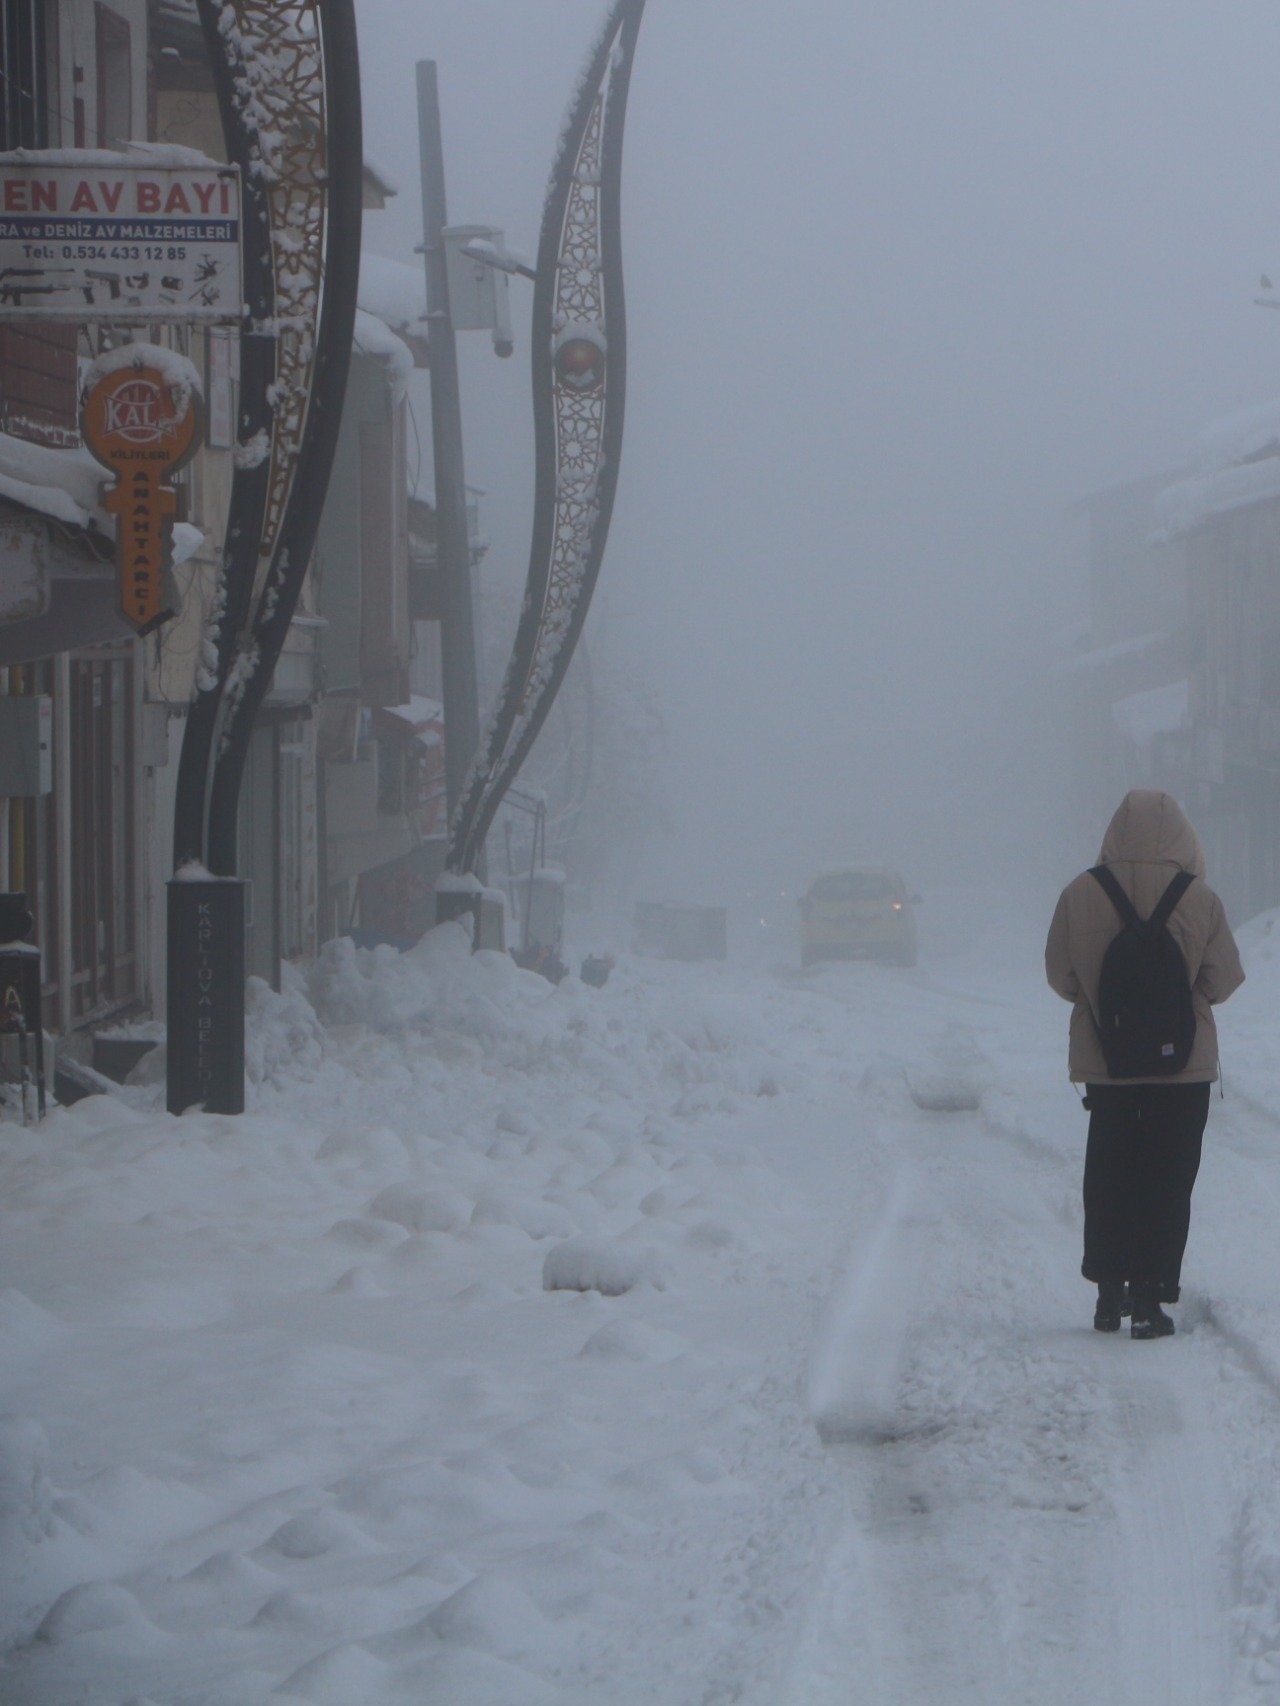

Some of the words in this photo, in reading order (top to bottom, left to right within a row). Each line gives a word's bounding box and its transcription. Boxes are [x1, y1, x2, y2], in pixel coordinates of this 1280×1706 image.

[4, 180, 57, 213] EN
[70, 181, 124, 213] AV
[22, 226, 40, 237] ve
[45, 221, 91, 237] DENİZ
[96, 225, 118, 238] AV
[121, 223, 231, 240] MALZEMELERİ
[23, 245, 54, 259] Tel:
[62, 245, 106, 259] 0.534
[110, 246, 139, 260] 433
[147, 247, 163, 260] 12
[168, 247, 186, 260] 85
[107, 398, 173, 433] KAL
[132, 471, 150, 616] ANAHTARCI
